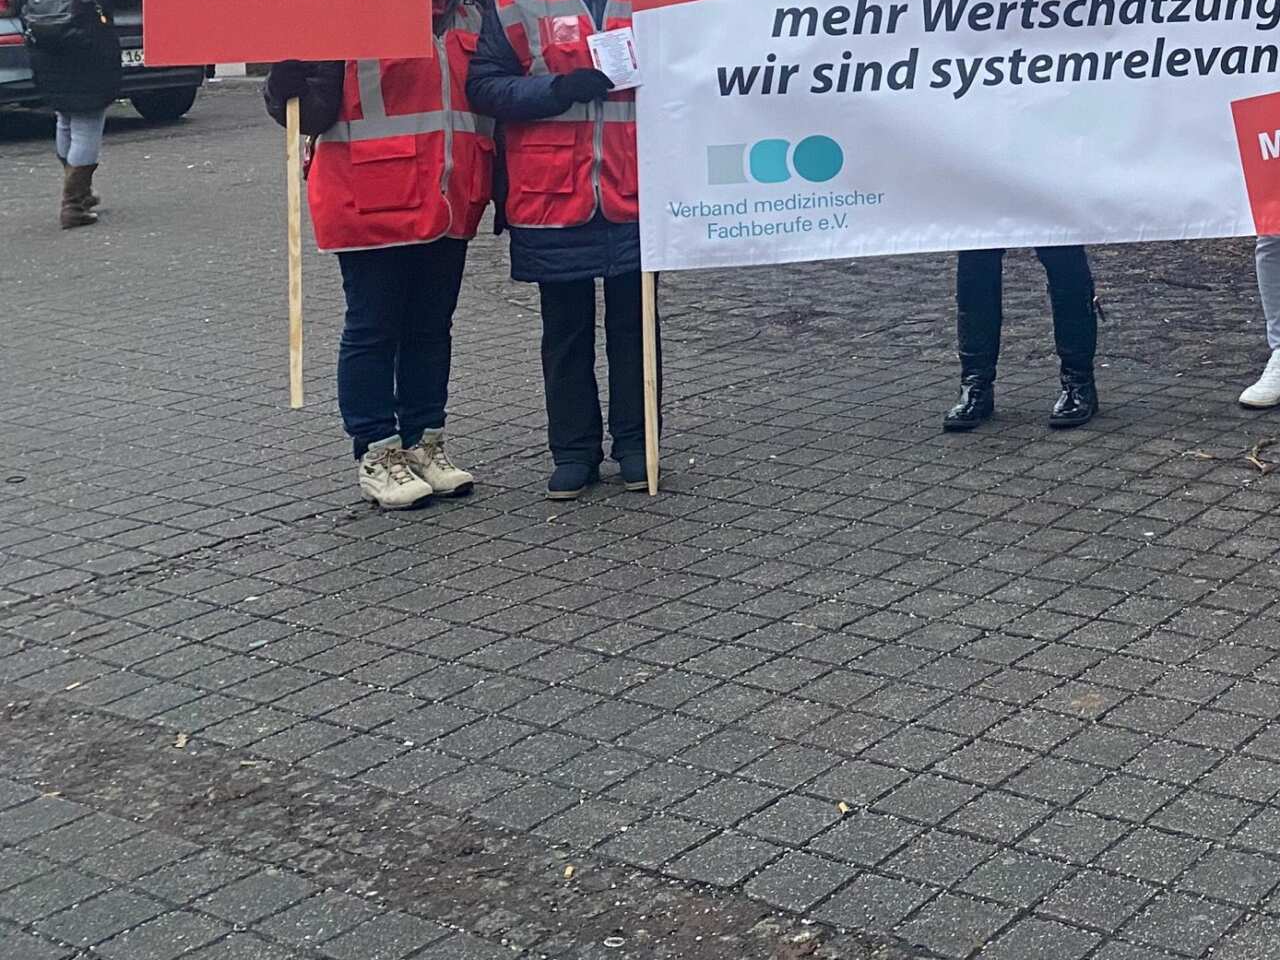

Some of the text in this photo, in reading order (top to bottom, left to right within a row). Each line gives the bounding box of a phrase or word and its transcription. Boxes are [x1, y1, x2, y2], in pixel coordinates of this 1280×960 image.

[717, 53, 800, 97] wir
[810, 47, 920, 94] sind
[668, 191, 885, 219] Verband medizinischer
[707, 213, 849, 240] Fachberufe e.V.
